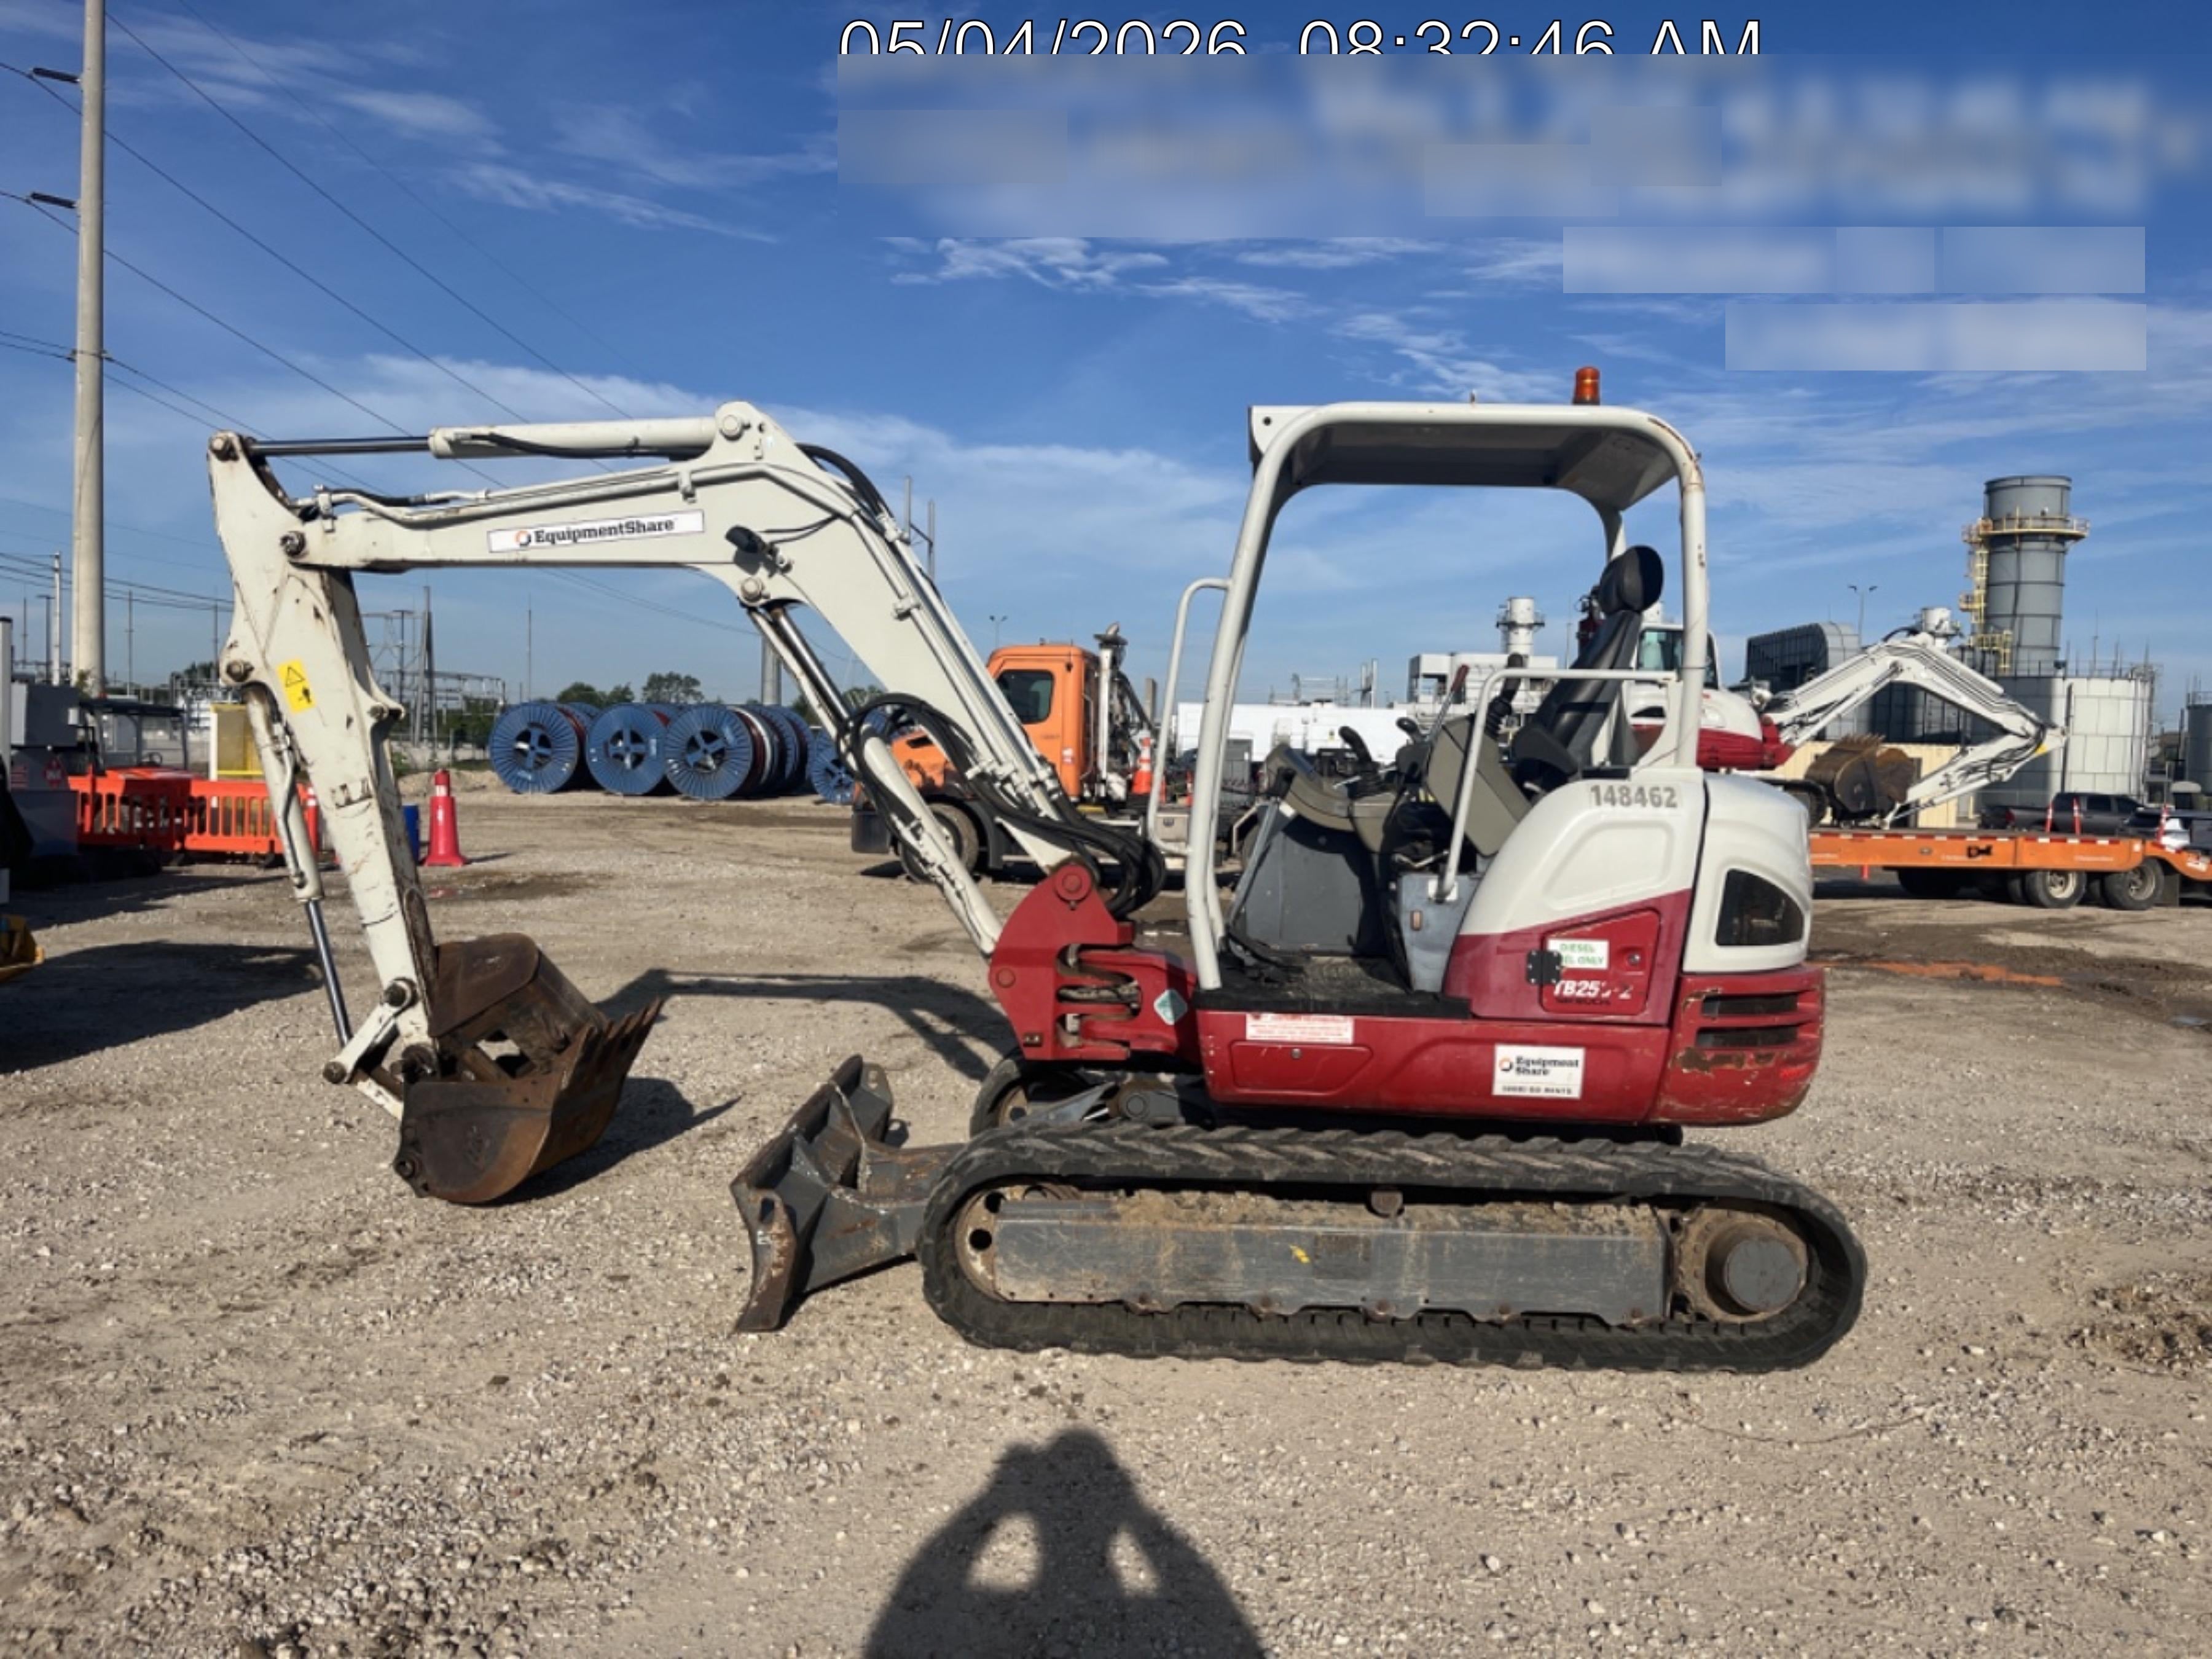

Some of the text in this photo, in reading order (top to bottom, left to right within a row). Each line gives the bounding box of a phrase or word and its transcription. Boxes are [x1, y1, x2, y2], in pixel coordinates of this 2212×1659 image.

[533, 519, 675, 544] EquipmentShare
[1590, 785, 1678, 808] 148462
[1560, 943, 1595, 952] DIESEL
[1577, 955, 1604, 965] ONLY
[1515, 1056, 1579, 1068] Equipment
[1515, 1067, 1550, 1075] Share
